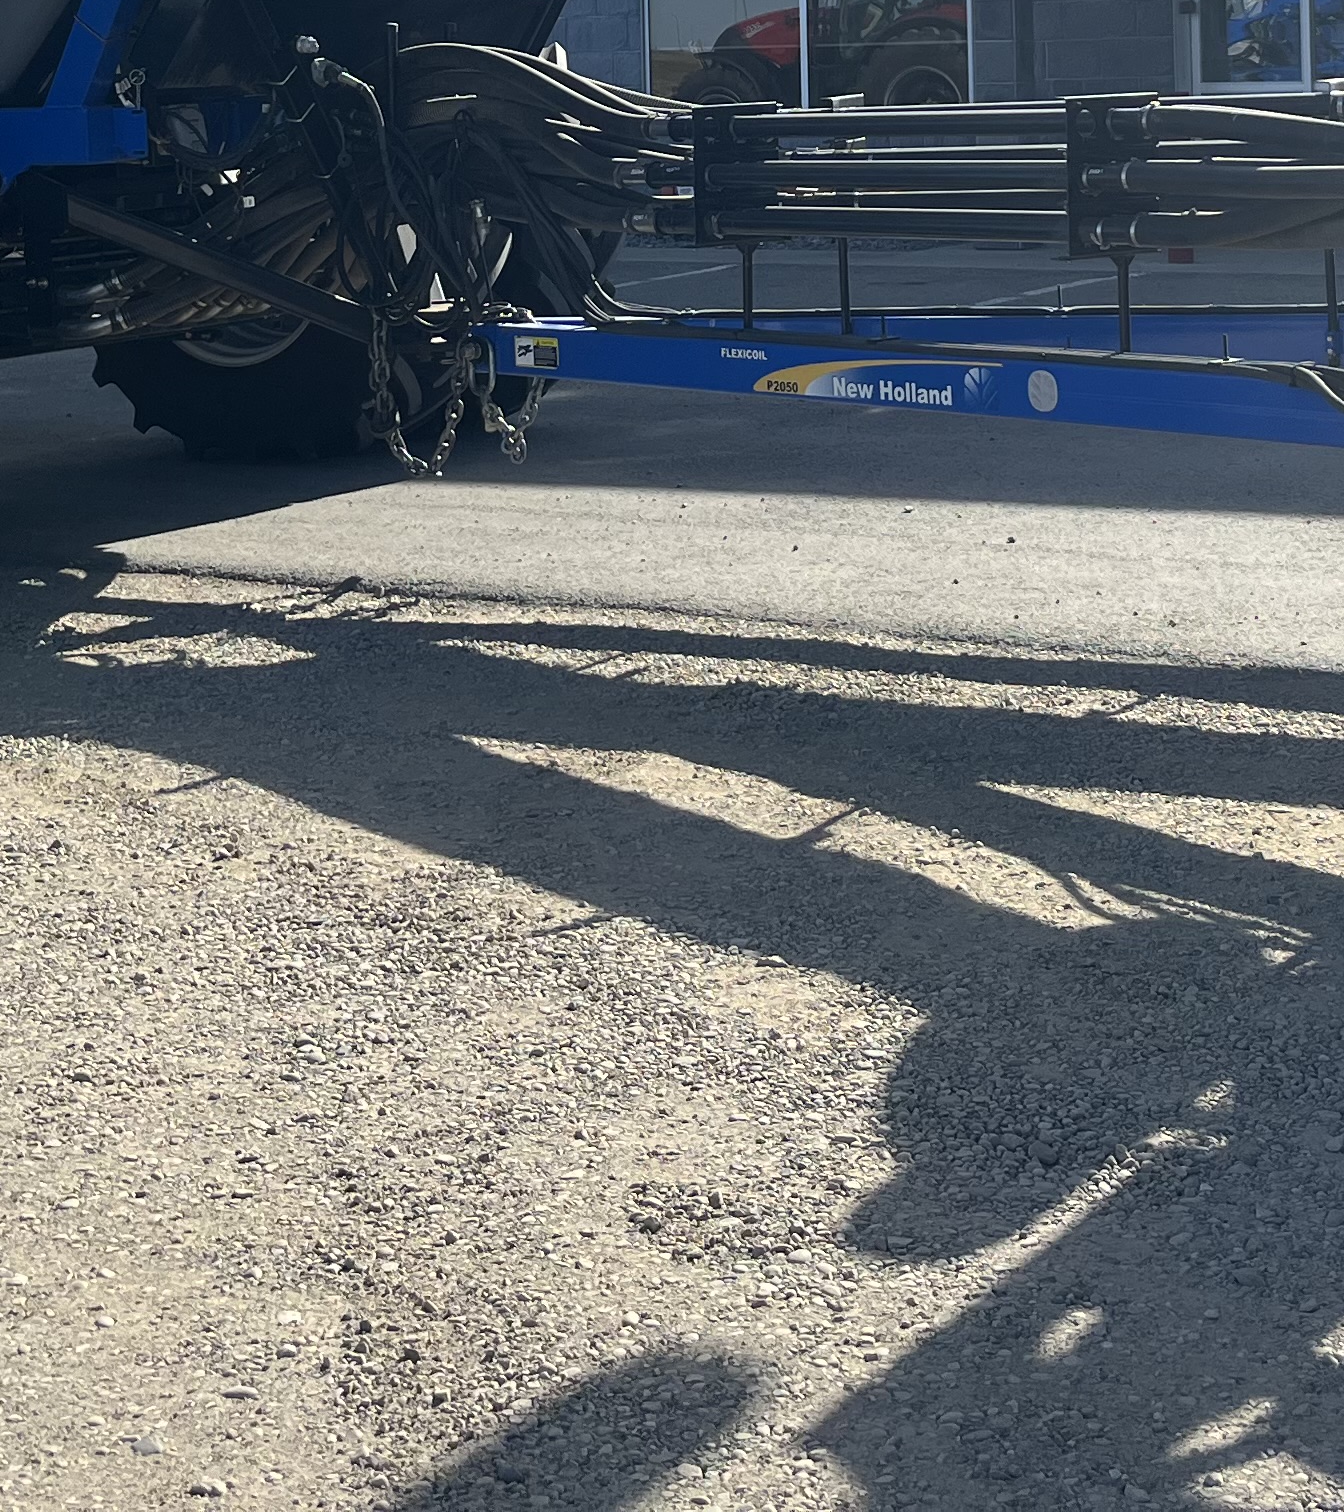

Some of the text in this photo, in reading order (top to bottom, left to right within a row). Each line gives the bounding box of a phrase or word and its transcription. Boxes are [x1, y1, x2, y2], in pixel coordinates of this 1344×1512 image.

[720, 347, 768, 361] FLEXICOIL
[766, 380, 799, 393] P2050
[832, 375, 954, 406] New Holland
